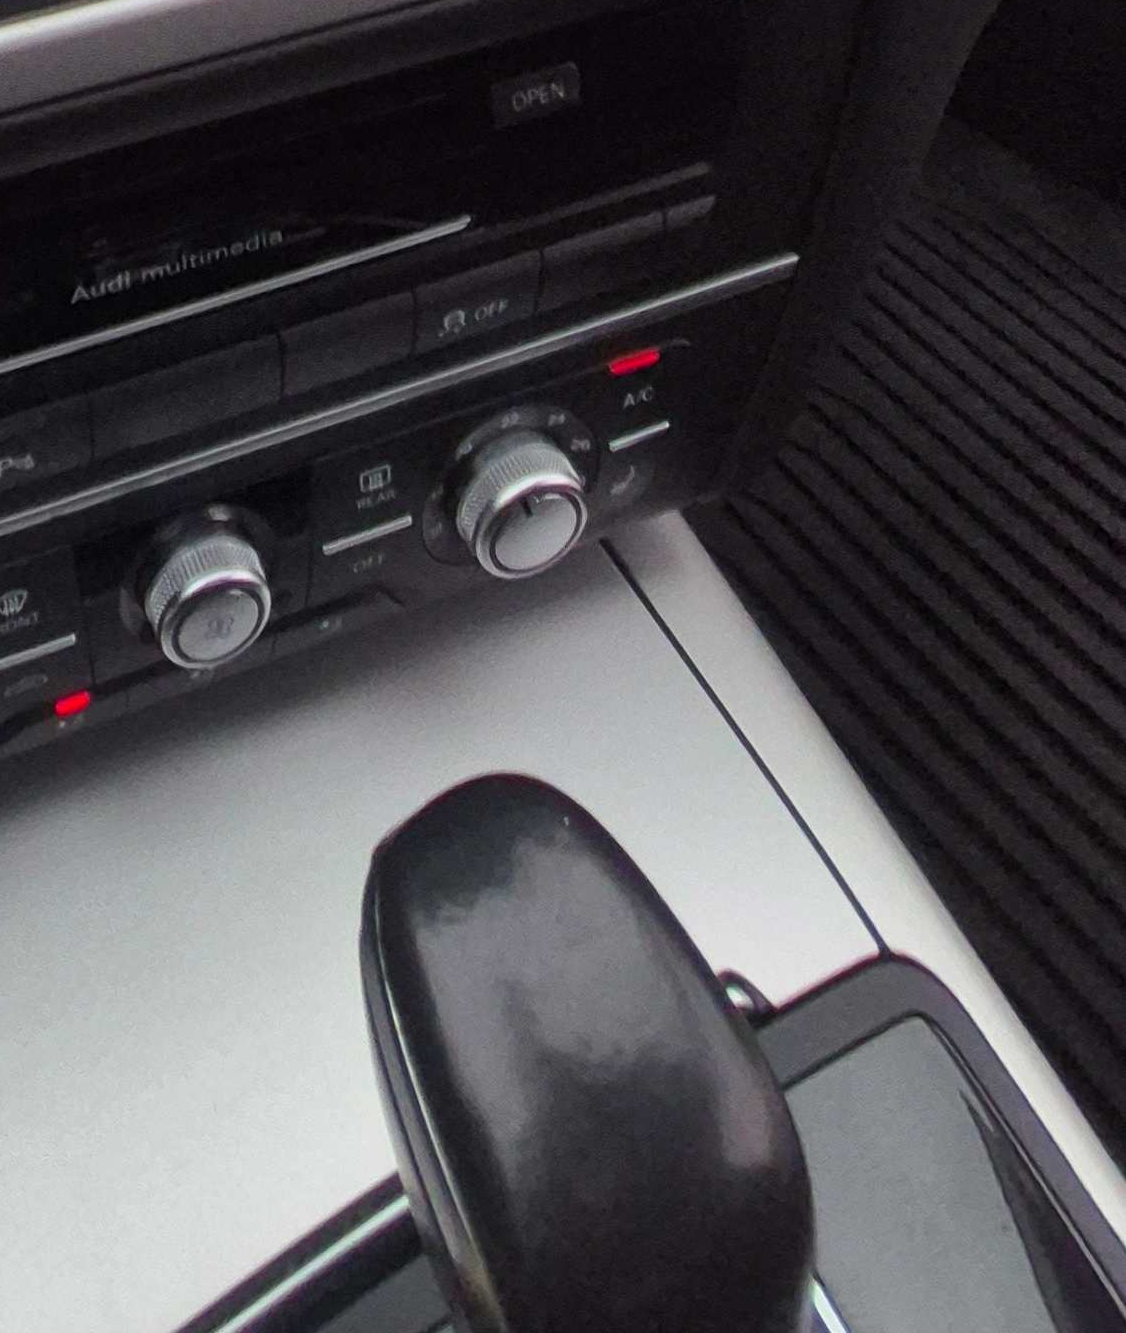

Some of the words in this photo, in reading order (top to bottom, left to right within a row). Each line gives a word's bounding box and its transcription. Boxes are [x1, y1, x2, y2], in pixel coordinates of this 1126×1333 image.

[512, 77, 566, 112] OPEN
[70, 269, 131, 305] Audi
[141, 230, 283, 283] multimedia
